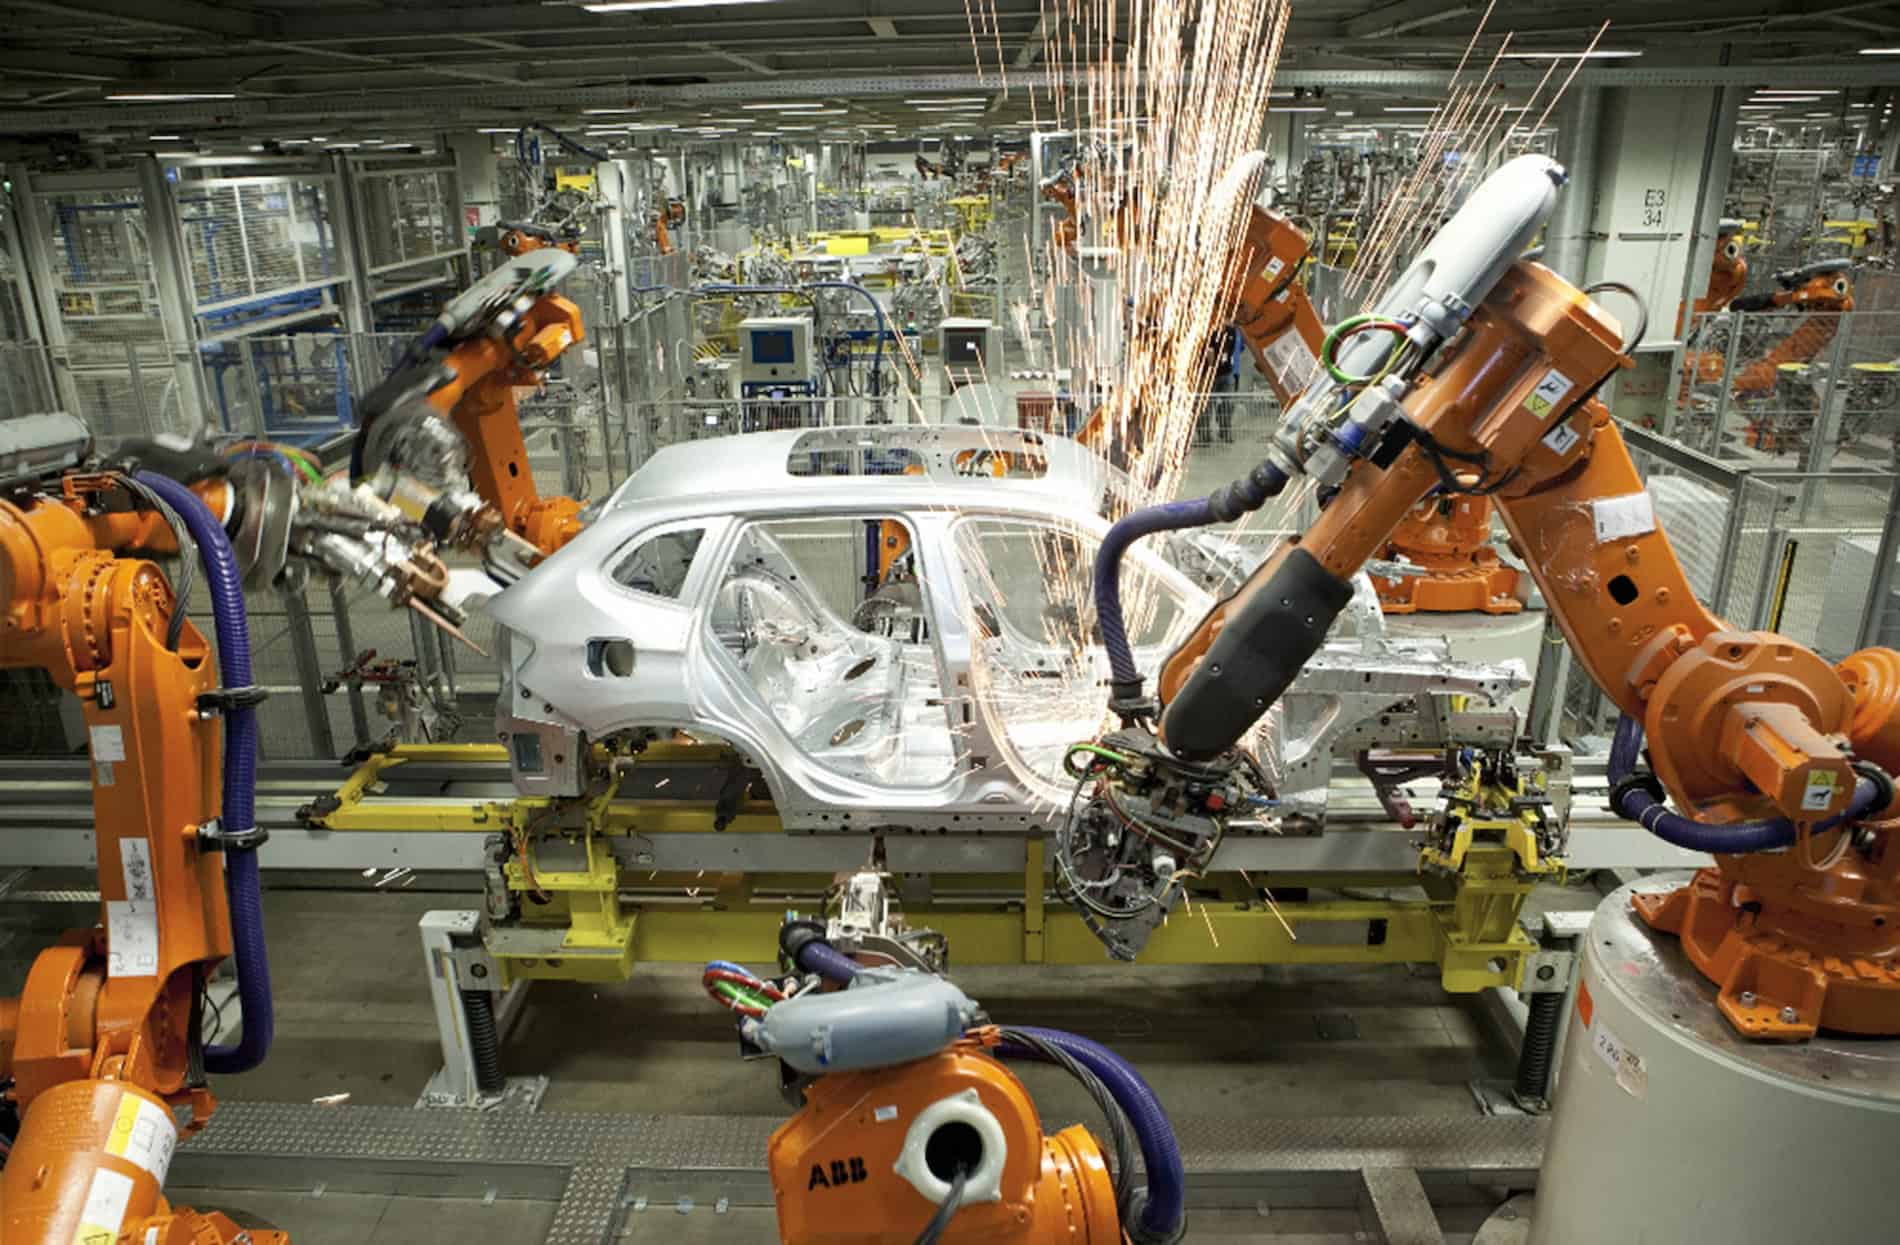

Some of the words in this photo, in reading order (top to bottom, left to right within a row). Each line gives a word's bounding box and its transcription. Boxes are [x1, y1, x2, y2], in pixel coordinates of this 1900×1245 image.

[1645, 188, 1664, 207] E3
[1643, 209, 1661, 227] 34
[808, 1156, 867, 1191] ABB
